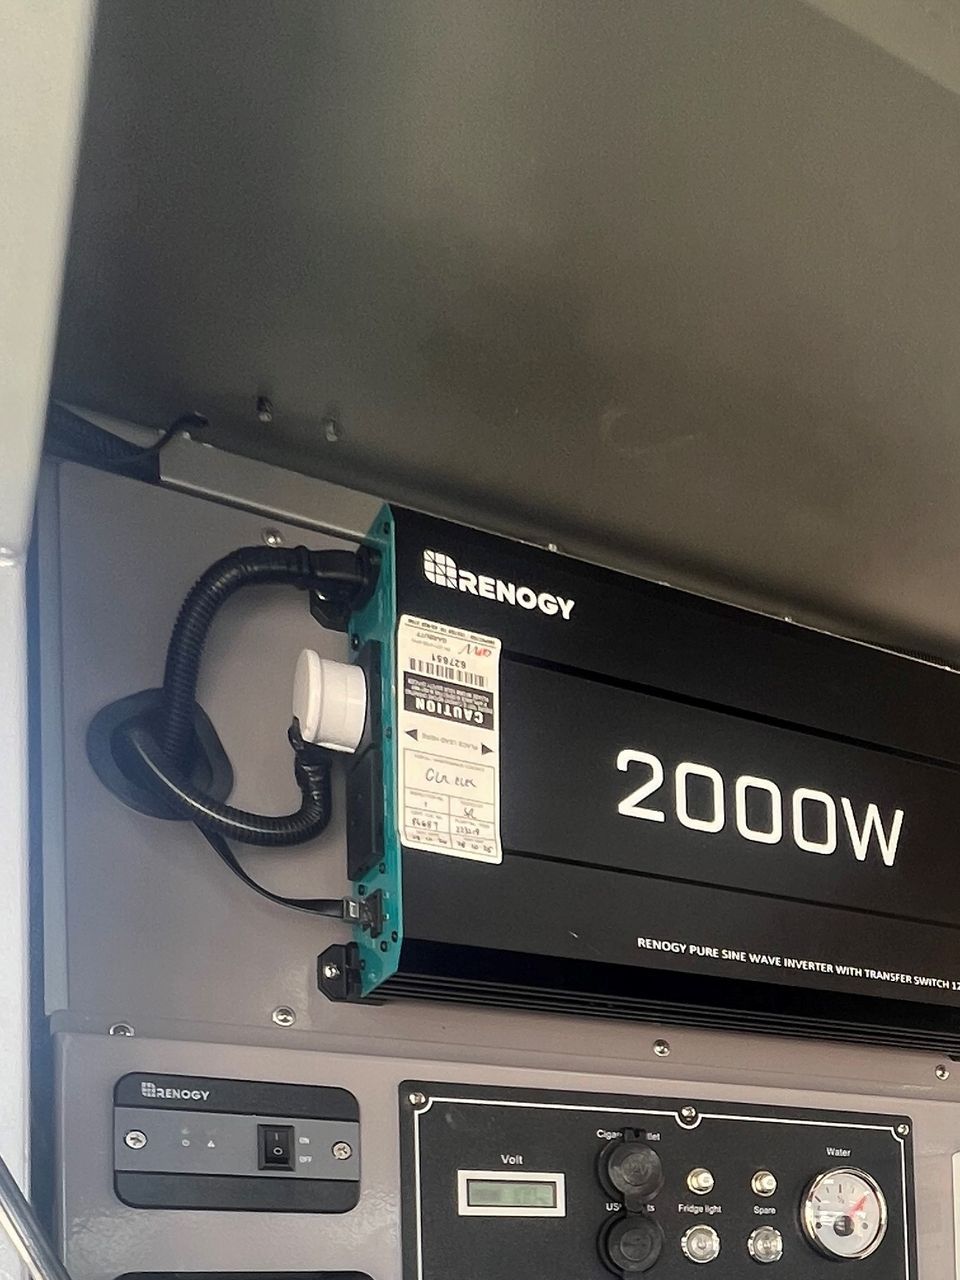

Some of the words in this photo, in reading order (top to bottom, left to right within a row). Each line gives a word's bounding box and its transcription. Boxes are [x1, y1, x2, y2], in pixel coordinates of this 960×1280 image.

[458, 569, 575, 620] RENOGY
[415, 697, 484, 724] CAUTION
[616, 749, 904, 867] 2000W
[637, 937, 687, 954] RENOGY
[689, 944, 720, 959] PURE
[721, 949, 747, 962] SINE
[748, 952, 782, 967] WAVE
[783, 957, 834, 974] INVERTER
[835, 963, 863, 977] WITH
[864, 968, 912, 984] TRANSFER
[913, 975, 950, 989] SWITCH
[156, 1087, 210, 1101] RENOGY
[501, 1152, 523, 1166] Volt
[826, 1147, 851, 1157] Water
[678, 1203, 704, 1214] Fridge
[704, 1205, 722, 1215] light
[753, 1205, 776, 1216] Spare
